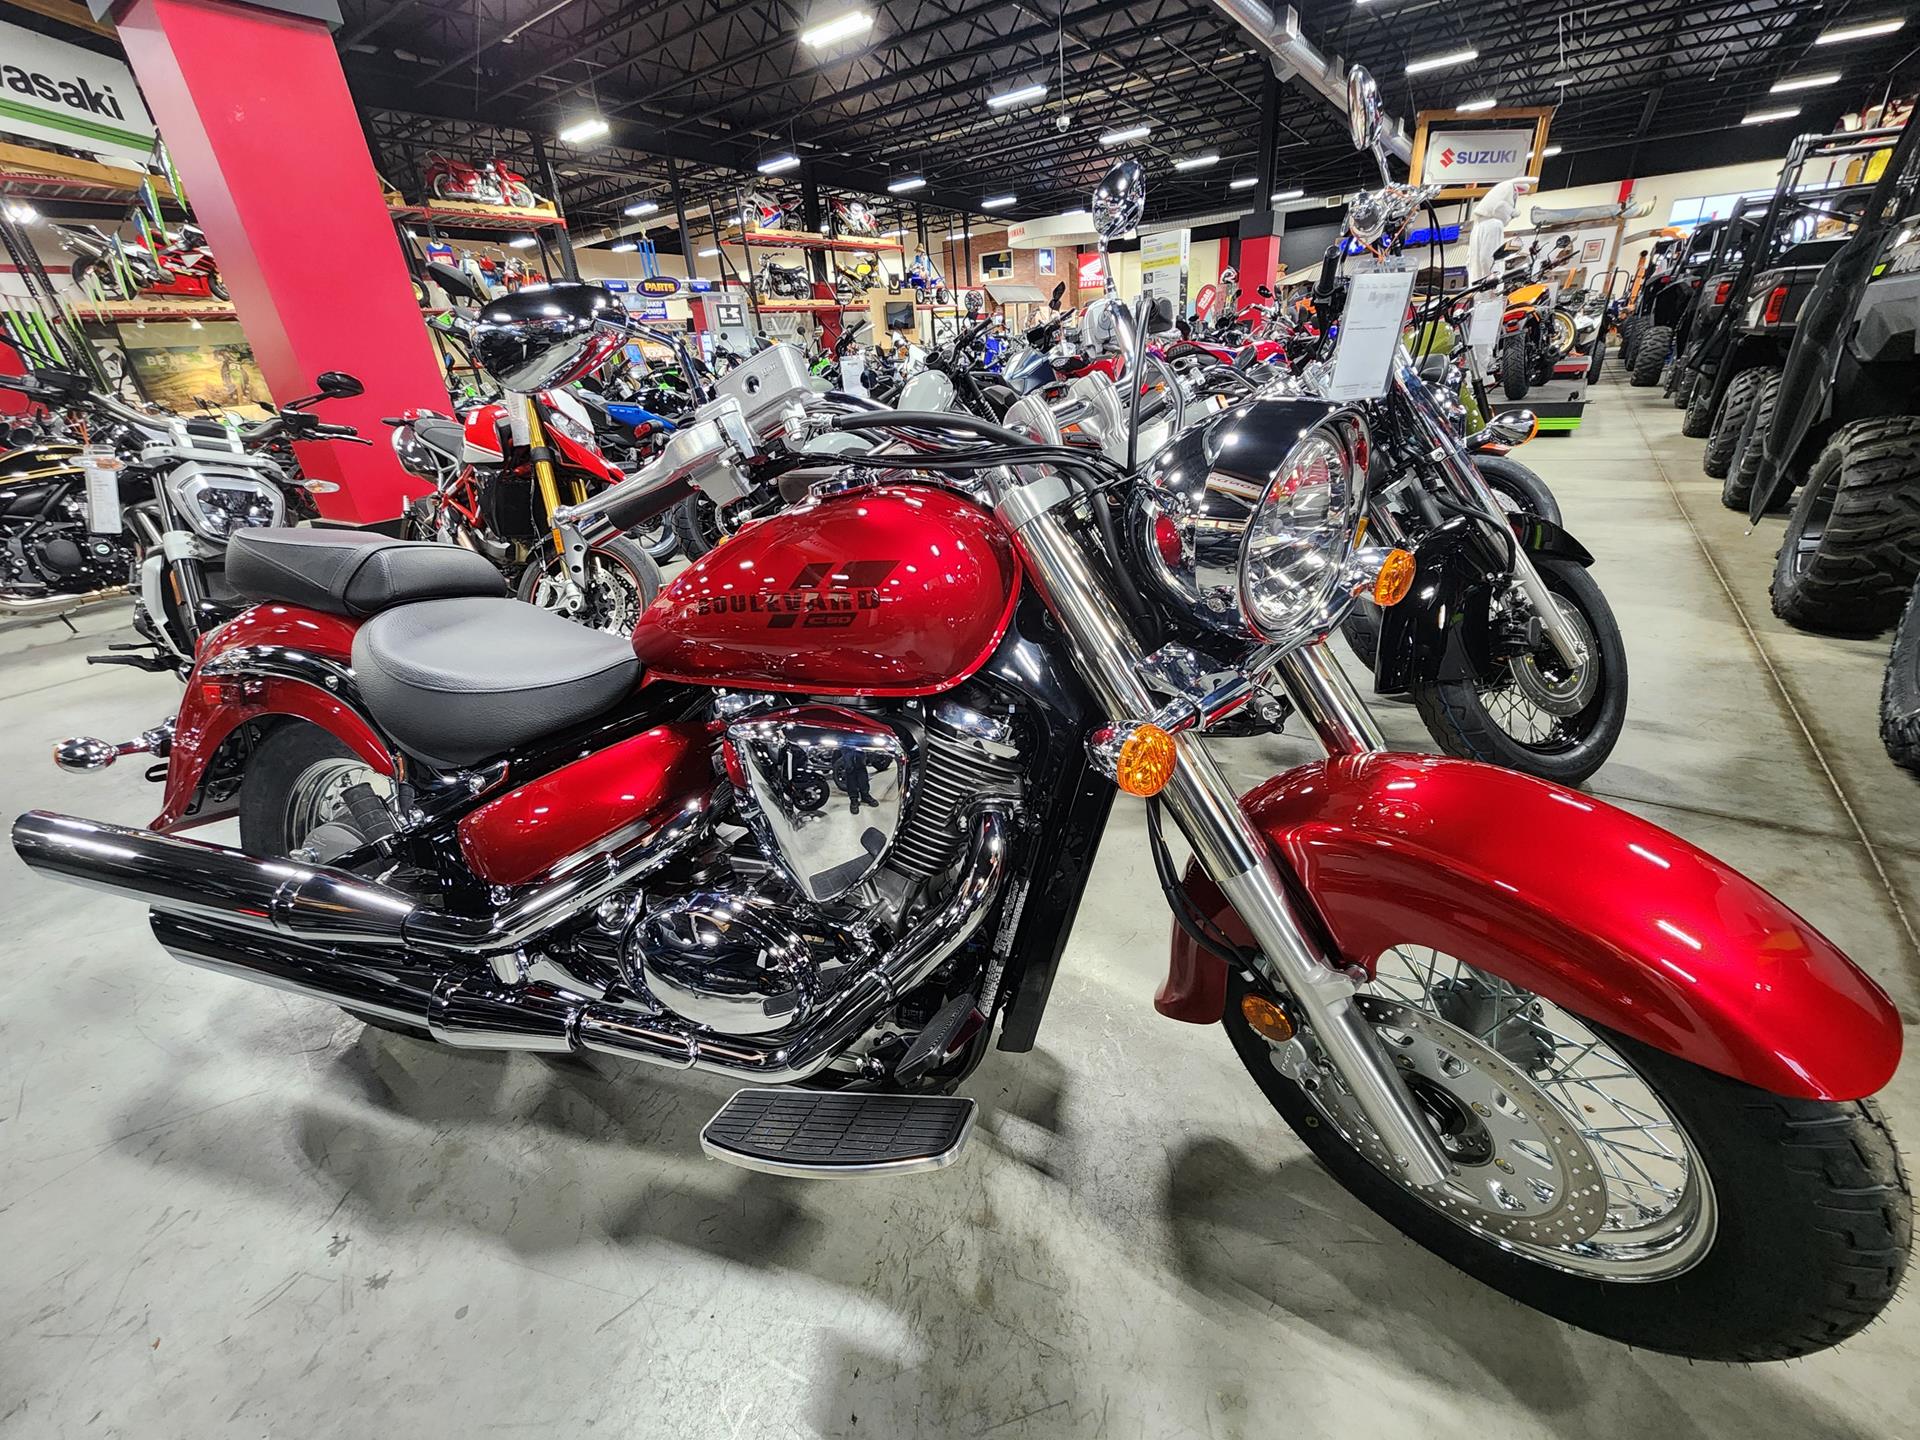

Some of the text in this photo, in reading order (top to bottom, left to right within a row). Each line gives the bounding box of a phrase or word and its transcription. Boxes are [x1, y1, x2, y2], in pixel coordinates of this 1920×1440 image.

[0, 64, 125, 121] asaki
[1456, 150, 1517, 165] SUZUKI
[644, 281, 675, 292] PARTS
[699, 590, 881, 615] BOULEVARD
